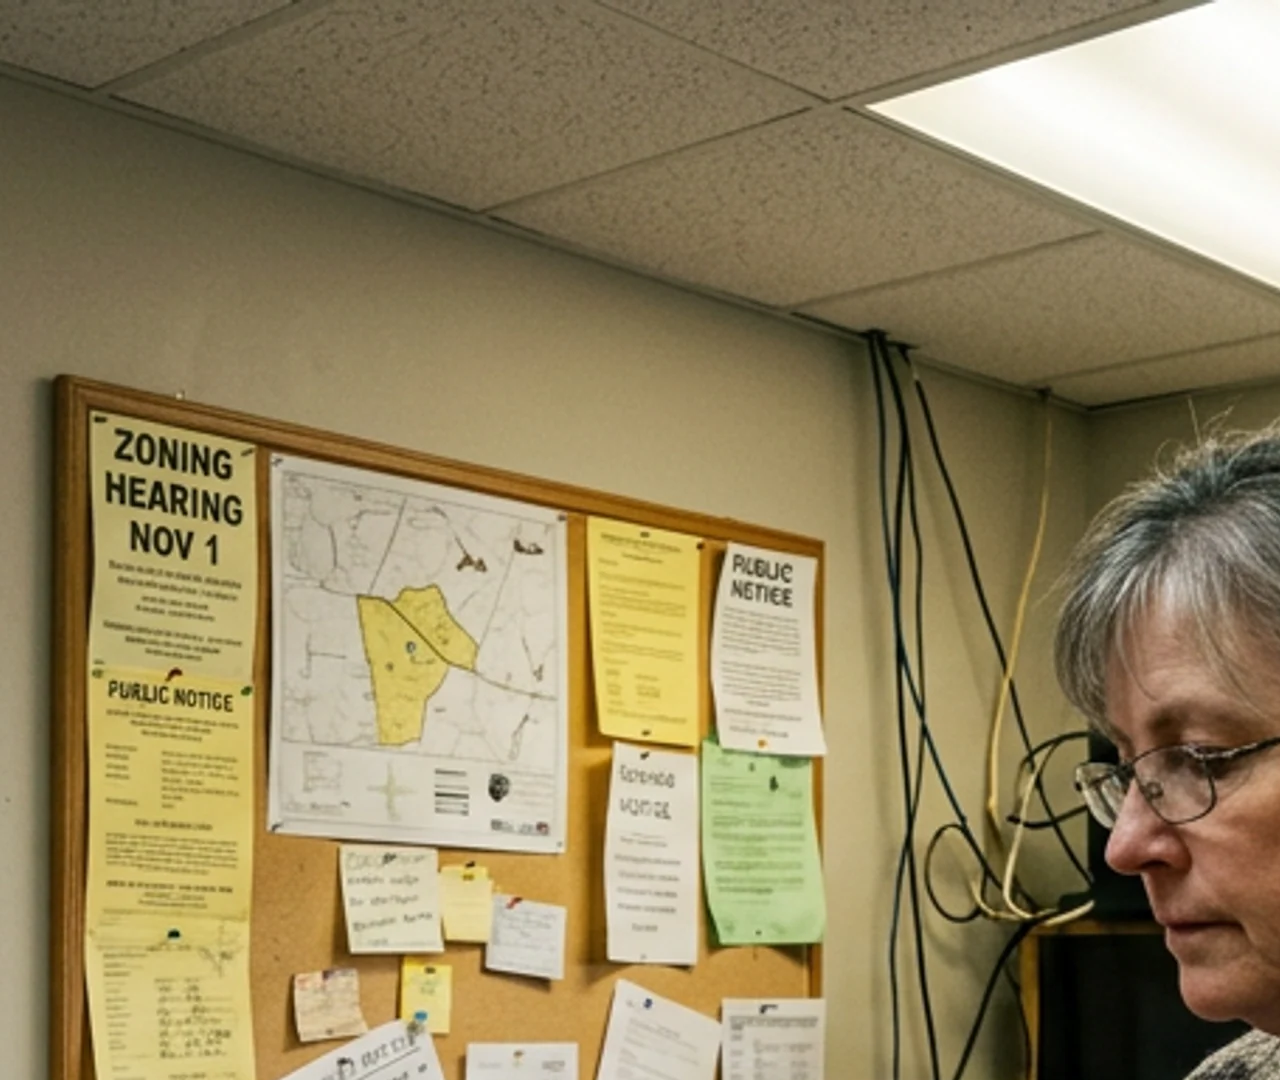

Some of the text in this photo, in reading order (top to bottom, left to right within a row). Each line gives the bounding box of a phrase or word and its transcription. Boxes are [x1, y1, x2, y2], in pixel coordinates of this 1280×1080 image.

[114, 427, 233, 480] ZONING
[105, 470, 243, 527] HEARING
[130, 520, 218, 566] NOV 1
